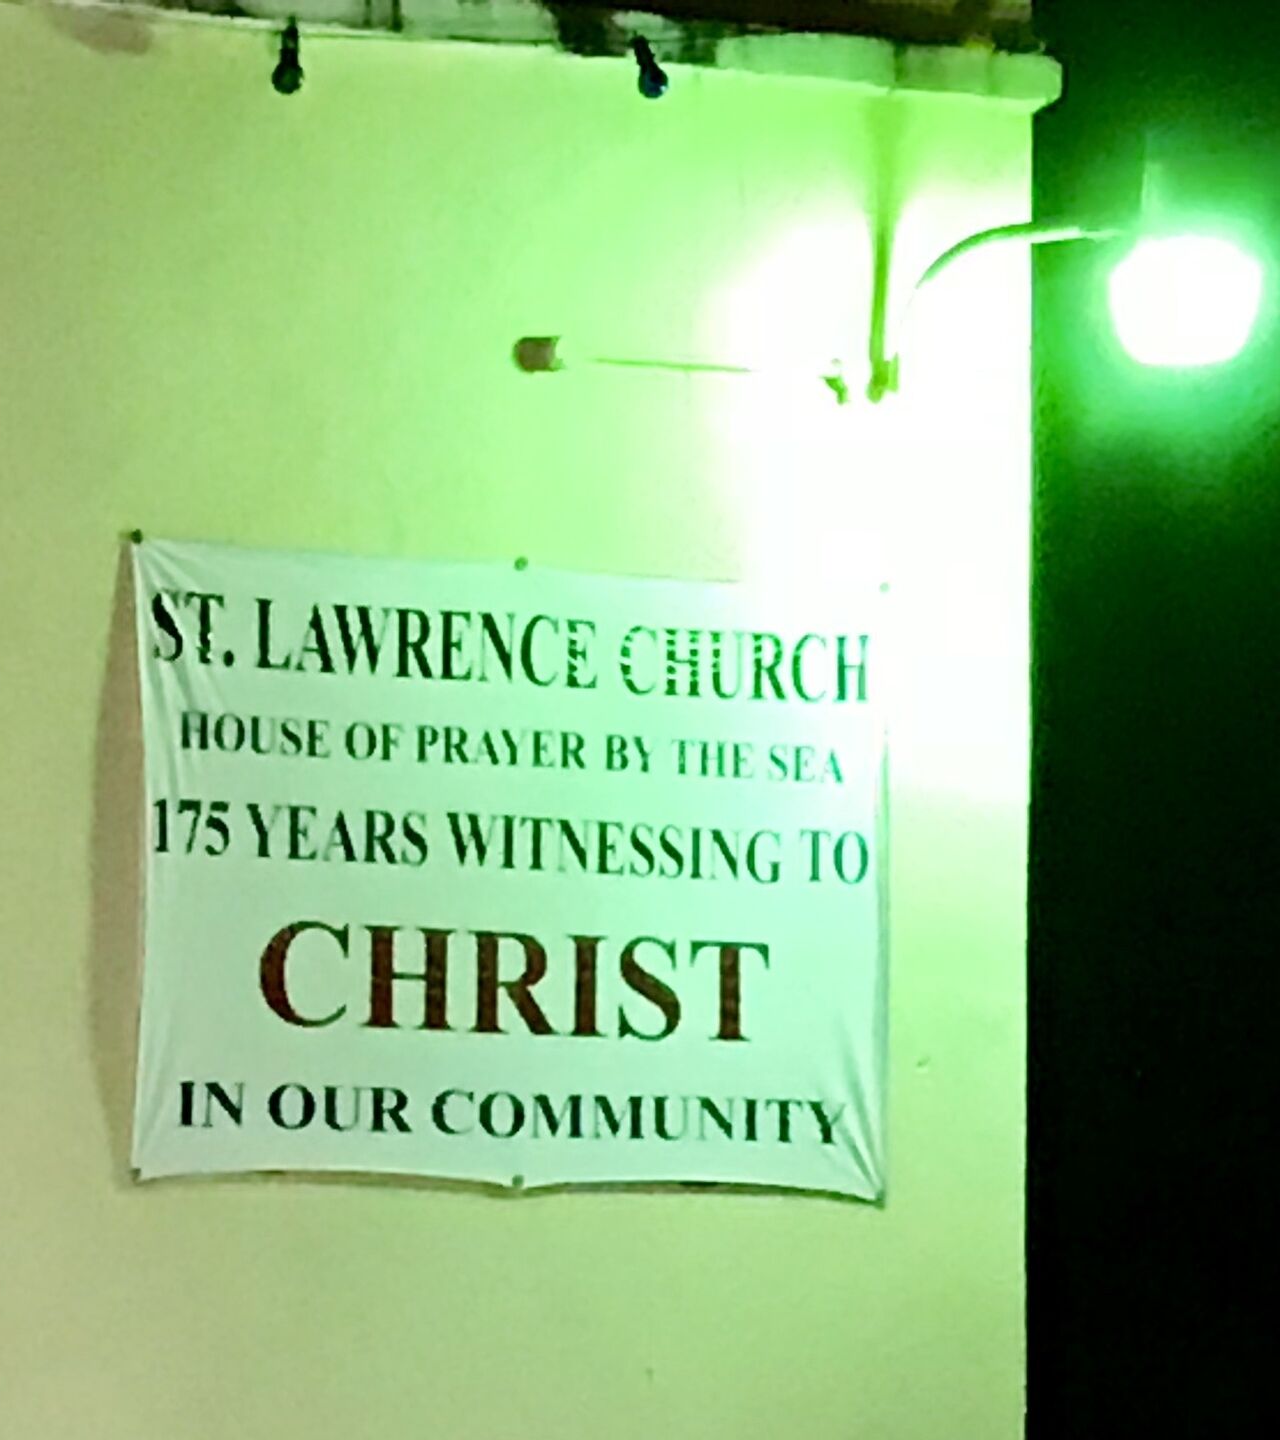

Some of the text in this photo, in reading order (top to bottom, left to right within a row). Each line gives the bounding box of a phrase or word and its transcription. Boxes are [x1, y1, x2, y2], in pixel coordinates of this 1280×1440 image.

[151, 592, 868, 702] ST. LAWRENCE CHURCH
[179, 710, 844, 785] HOUSE OF PRAYER BY THE SEA
[152, 798, 868, 884] 175 YEARS WITNESSING TO
[258, 920, 771, 1042] CHRIST
[178, 1081, 846, 1146] IN OUR COMMUNITY
